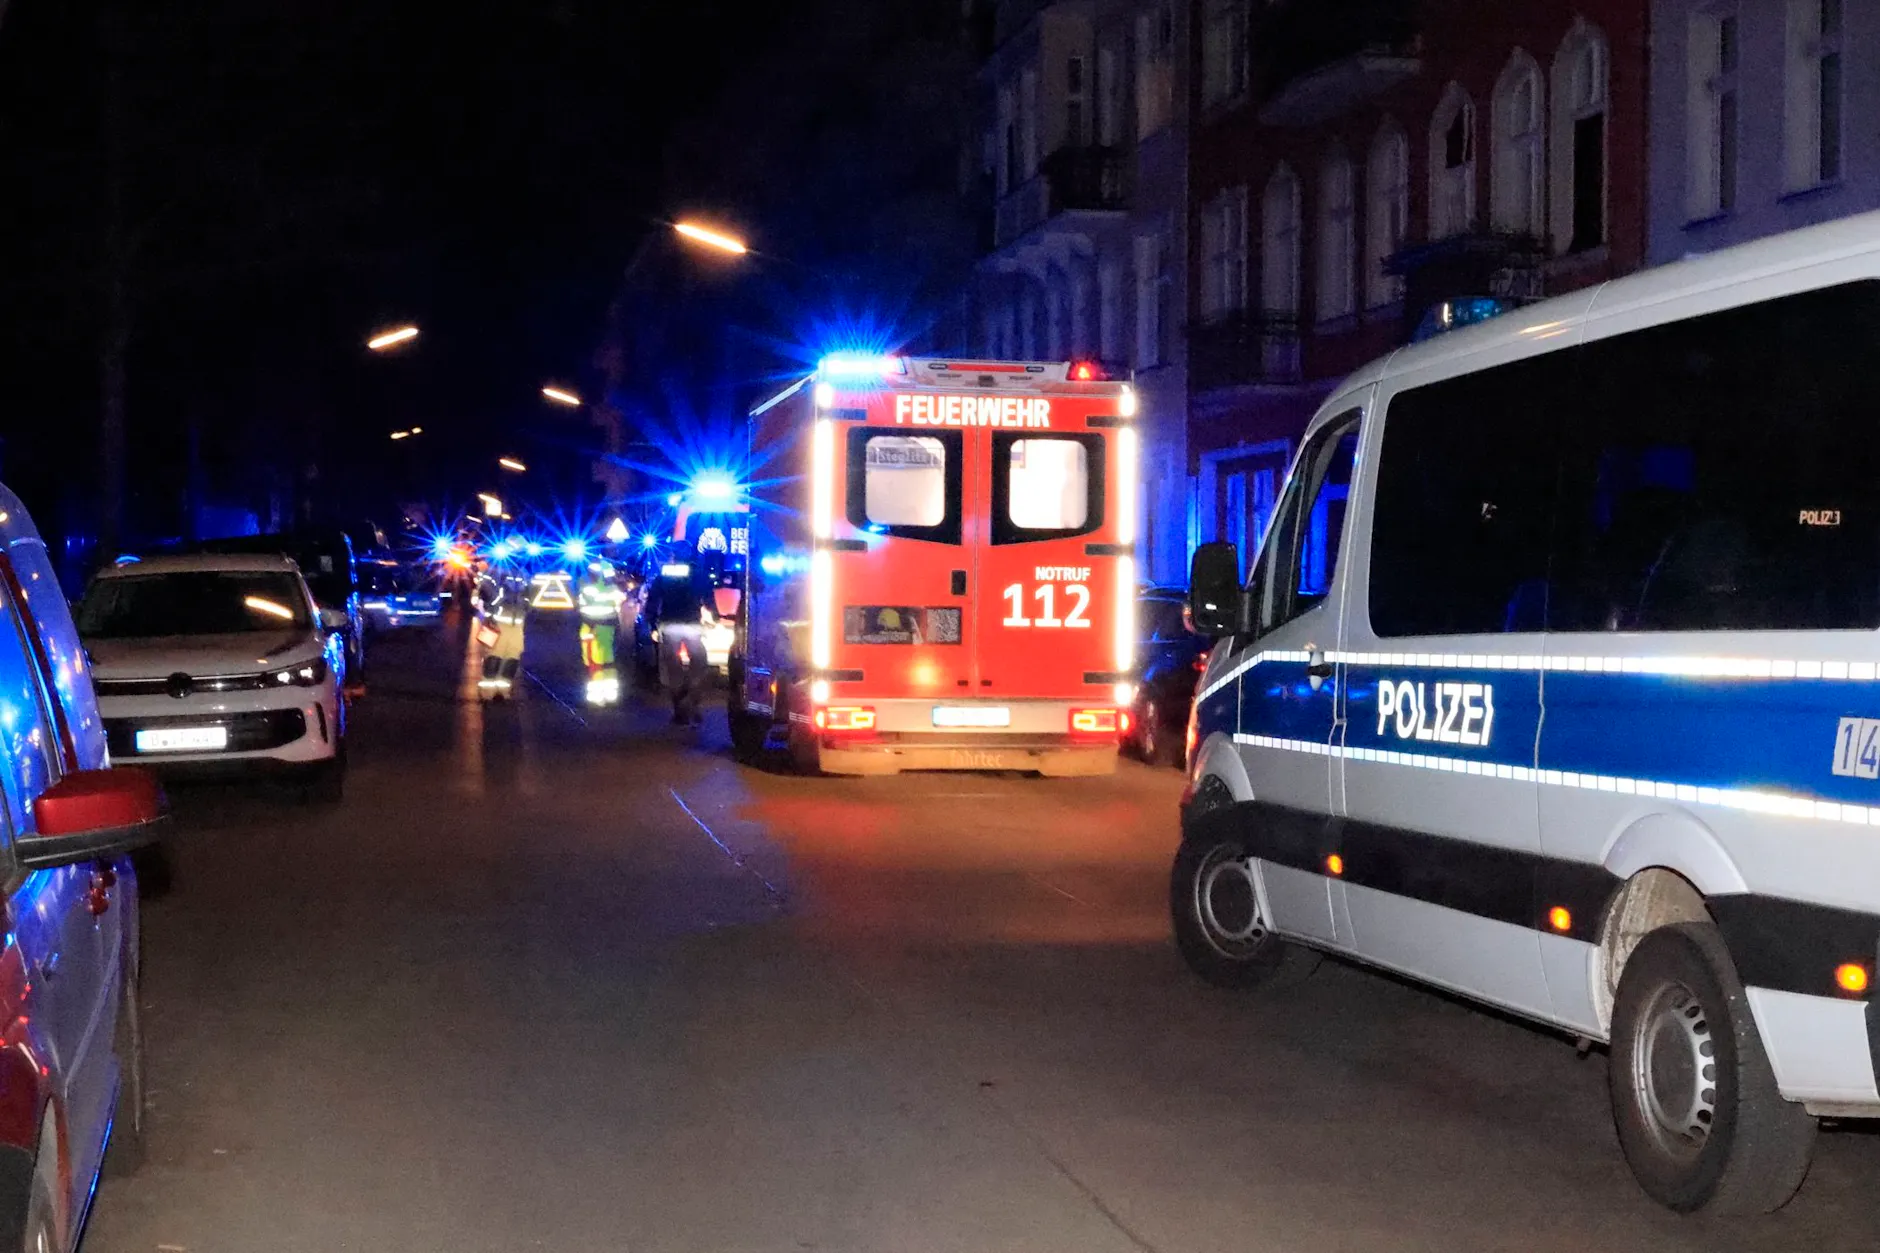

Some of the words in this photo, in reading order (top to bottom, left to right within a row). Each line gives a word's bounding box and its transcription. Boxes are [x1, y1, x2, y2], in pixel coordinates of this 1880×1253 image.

[896, 394, 1050, 427] FEUERWEHR
[1035, 566, 1091, 581] NOTRUF
[1003, 583, 1091, 628] 112
[1377, 680, 1494, 746] POLIZEI
[1842, 723, 1878, 773] 14
